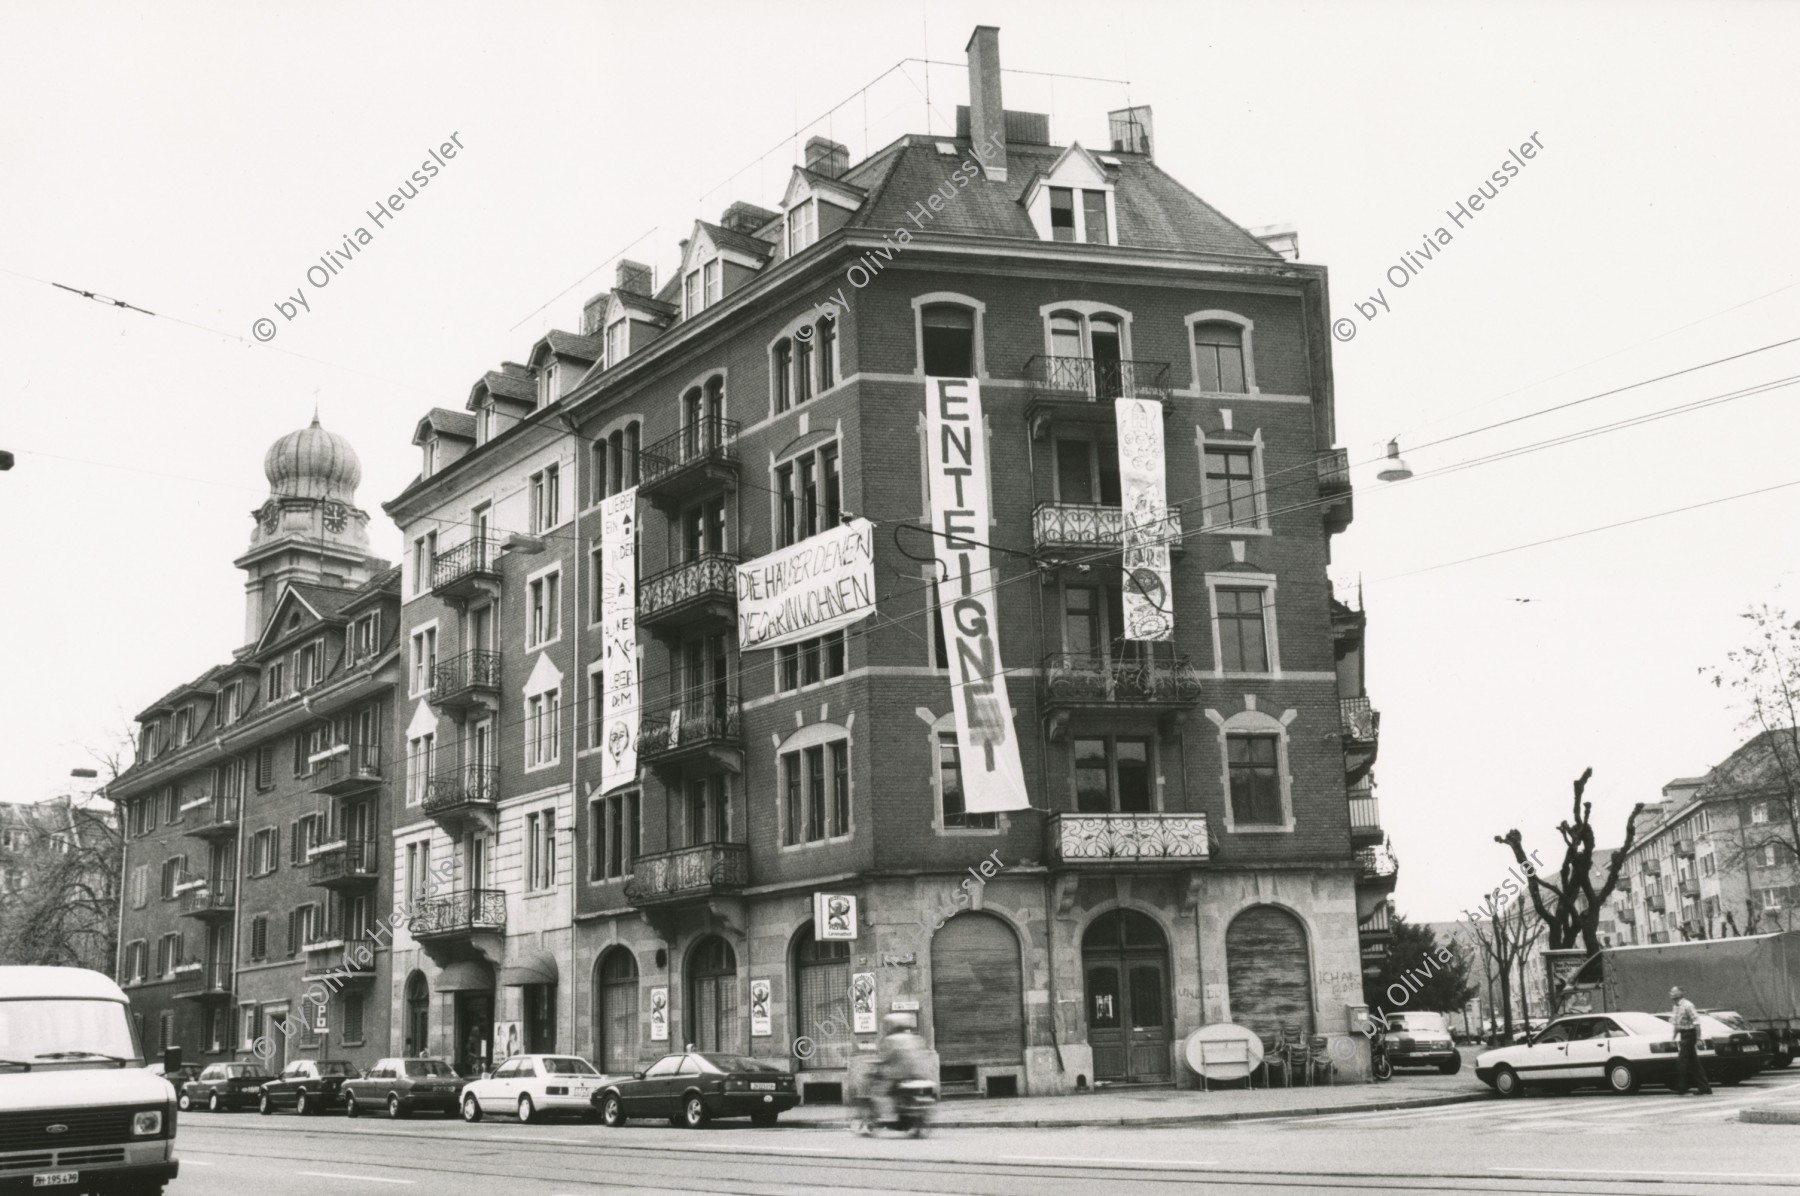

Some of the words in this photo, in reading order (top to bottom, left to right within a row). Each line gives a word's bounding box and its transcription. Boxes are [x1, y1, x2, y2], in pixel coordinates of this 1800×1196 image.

[738, 568, 763, 602] DIE
[812, 528, 872, 577] DENEN
[740, 611, 761, 647] DIE
[757, 594, 800, 640] DARIN
[799, 572, 872, 626] WOHNEN
[318, 1005, 326, 1017] P
